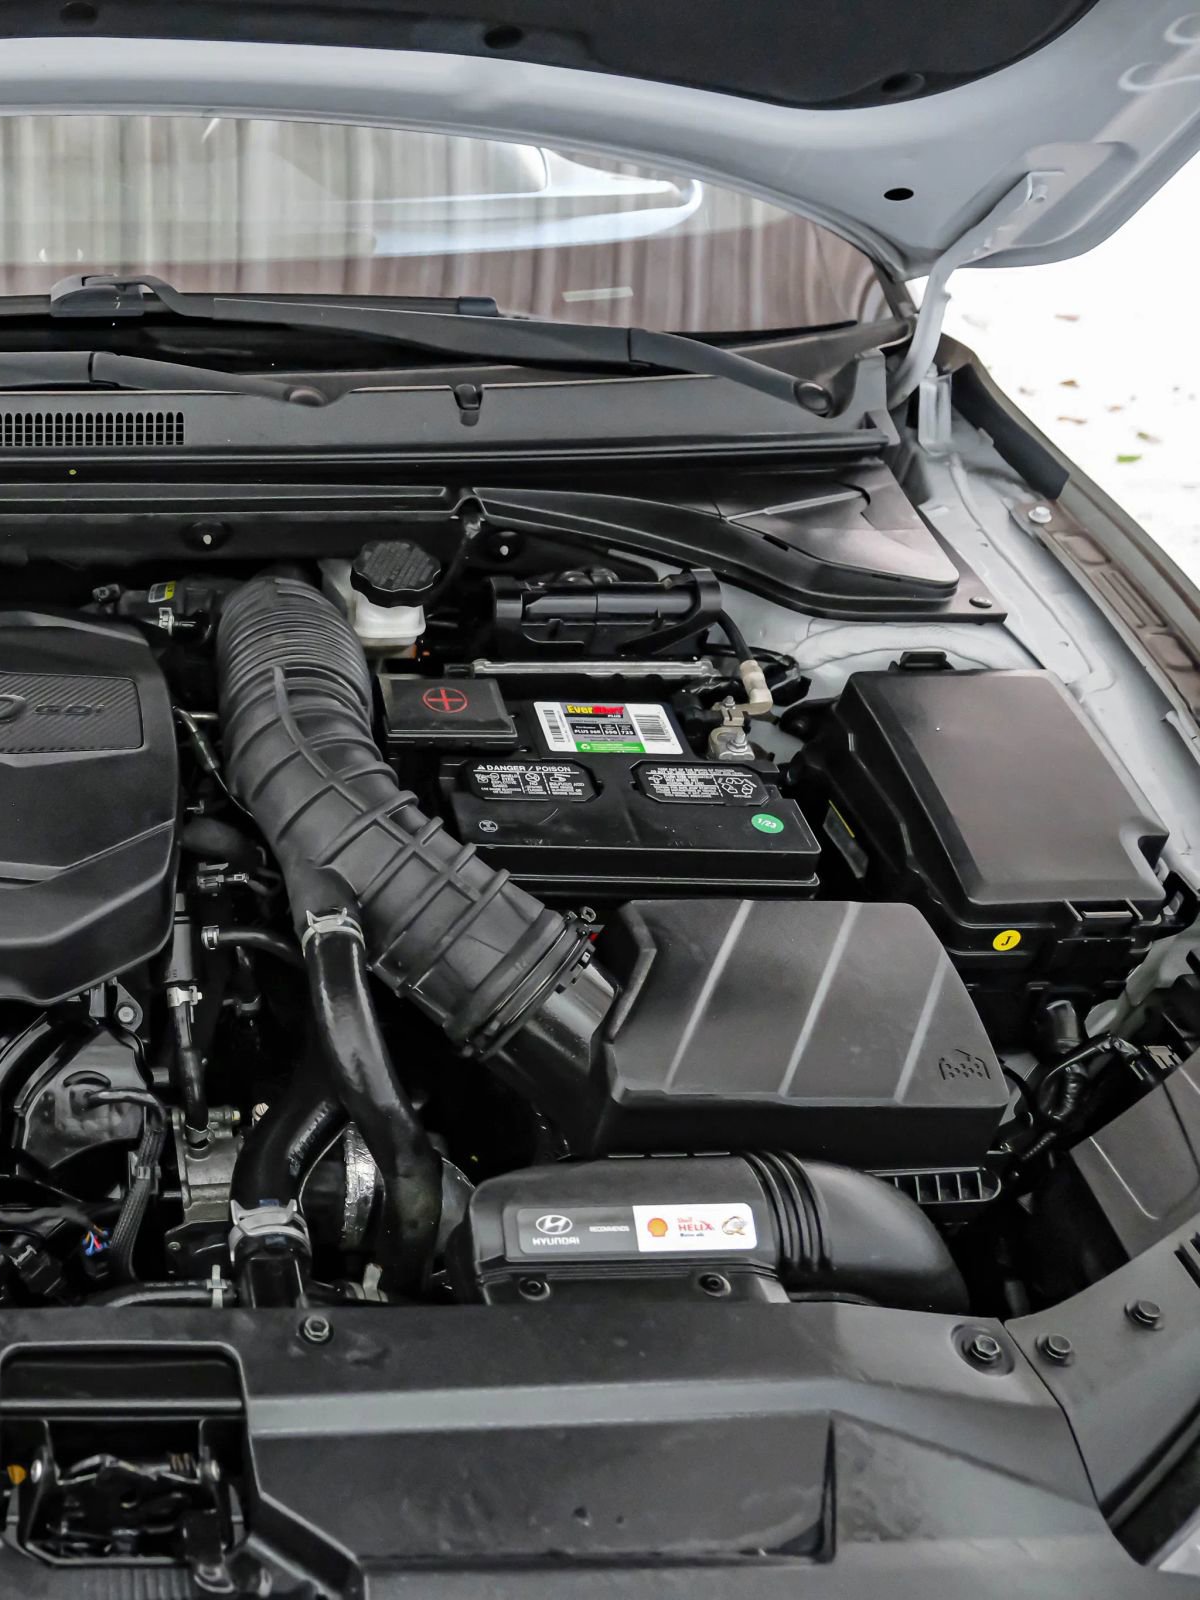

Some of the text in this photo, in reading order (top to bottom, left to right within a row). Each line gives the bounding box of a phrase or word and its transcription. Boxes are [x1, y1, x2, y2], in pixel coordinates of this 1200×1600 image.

[486, 764, 526, 772] DANGER
[535, 765, 572, 773] POISON
[1000, 935, 1012, 947] J
[678, 1220, 715, 1231] HELIX
[531, 1236, 580, 1246] HYUNDAI
